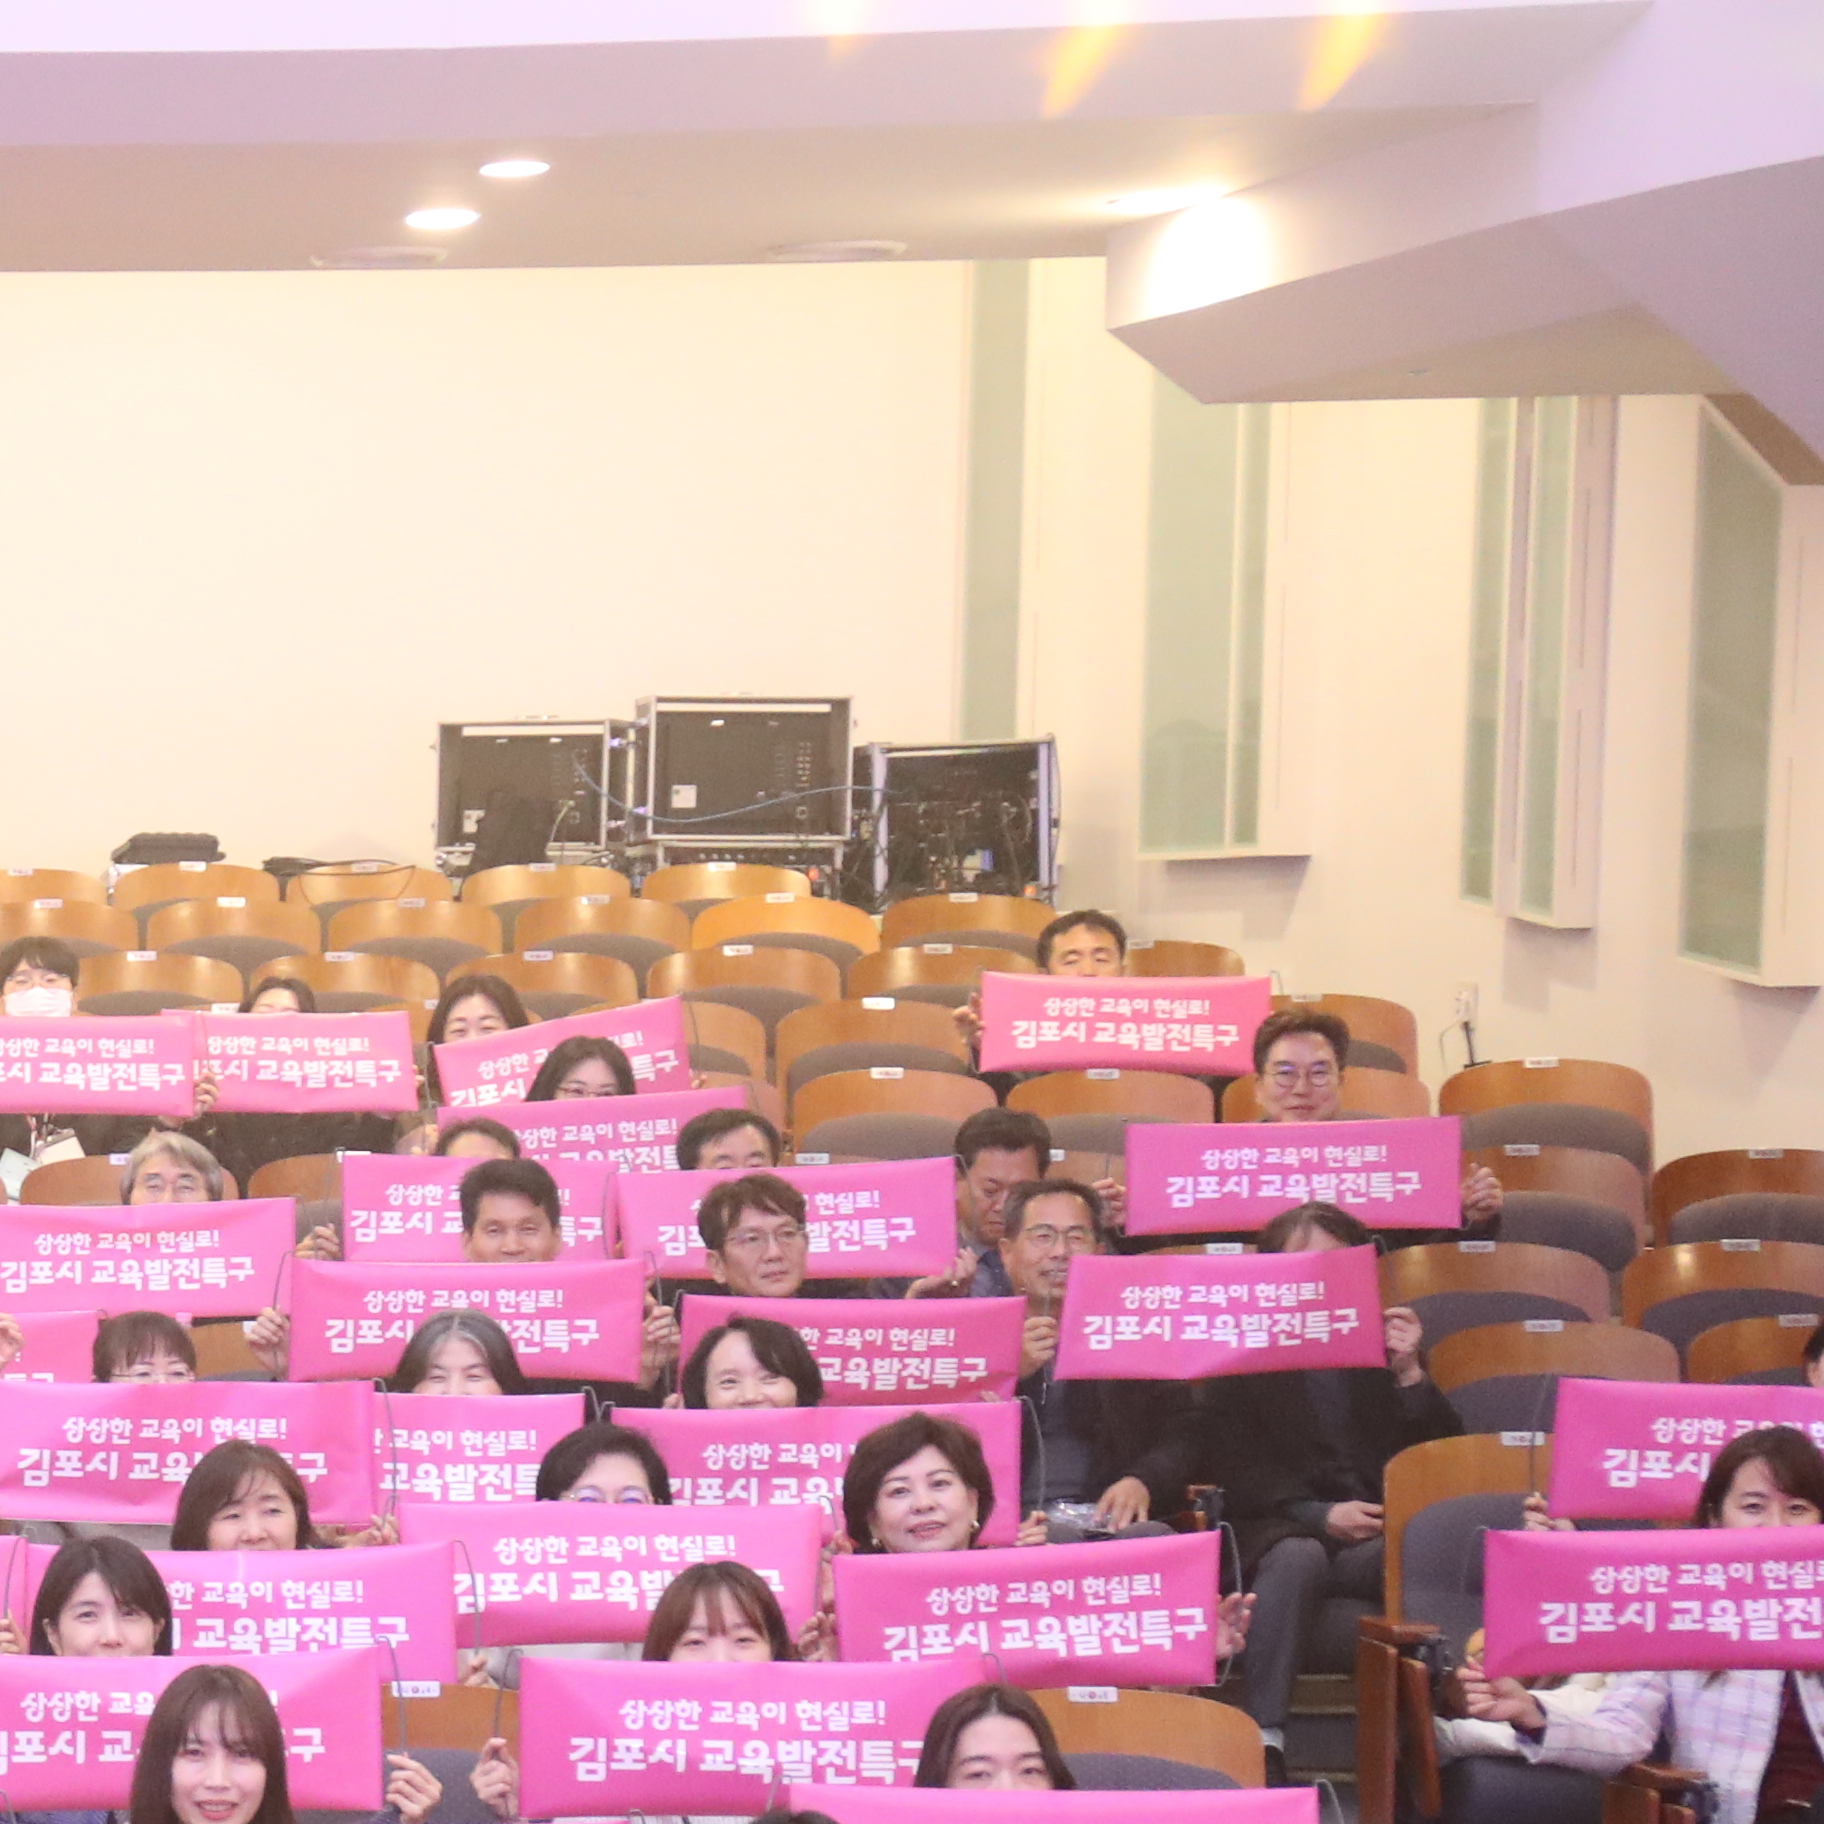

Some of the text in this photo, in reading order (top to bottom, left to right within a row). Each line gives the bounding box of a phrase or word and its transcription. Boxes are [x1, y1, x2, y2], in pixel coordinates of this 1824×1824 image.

[1043, 996, 1210, 1020] 상상한 교육이 현실로!
[43, 1038, 94, 1058] 교육이
[97, 1037, 155, 1059] 현실로!
[1010, 1020, 1240, 1052] 김포시 교육발전특구
[38, 1062, 186, 1092] 교육발전특구
[1201, 1144, 1388, 1171] 상상한 교육이 현실로!
[1165, 1170, 1422, 1208] 김포시 교육발전특구
[33, 1229, 220, 1256] 상상한 교육이 현실로!
[0, 1256, 256, 1294] 김포시 교육발전특구
[1120, 1281, 1325, 1310] 상상한 교육이 현실로!
[1082, 1308, 1359, 1351] 김포시 교육발전특구
[1590, 1562, 1754, 1595] 상상한 교육이
[925, 1573, 1162, 1617] 상상한 교육이 현실로!
[883, 1607, 1208, 1662] 김포시 교육발전특구
[1539, 1600, 1656, 1644] 김포시
